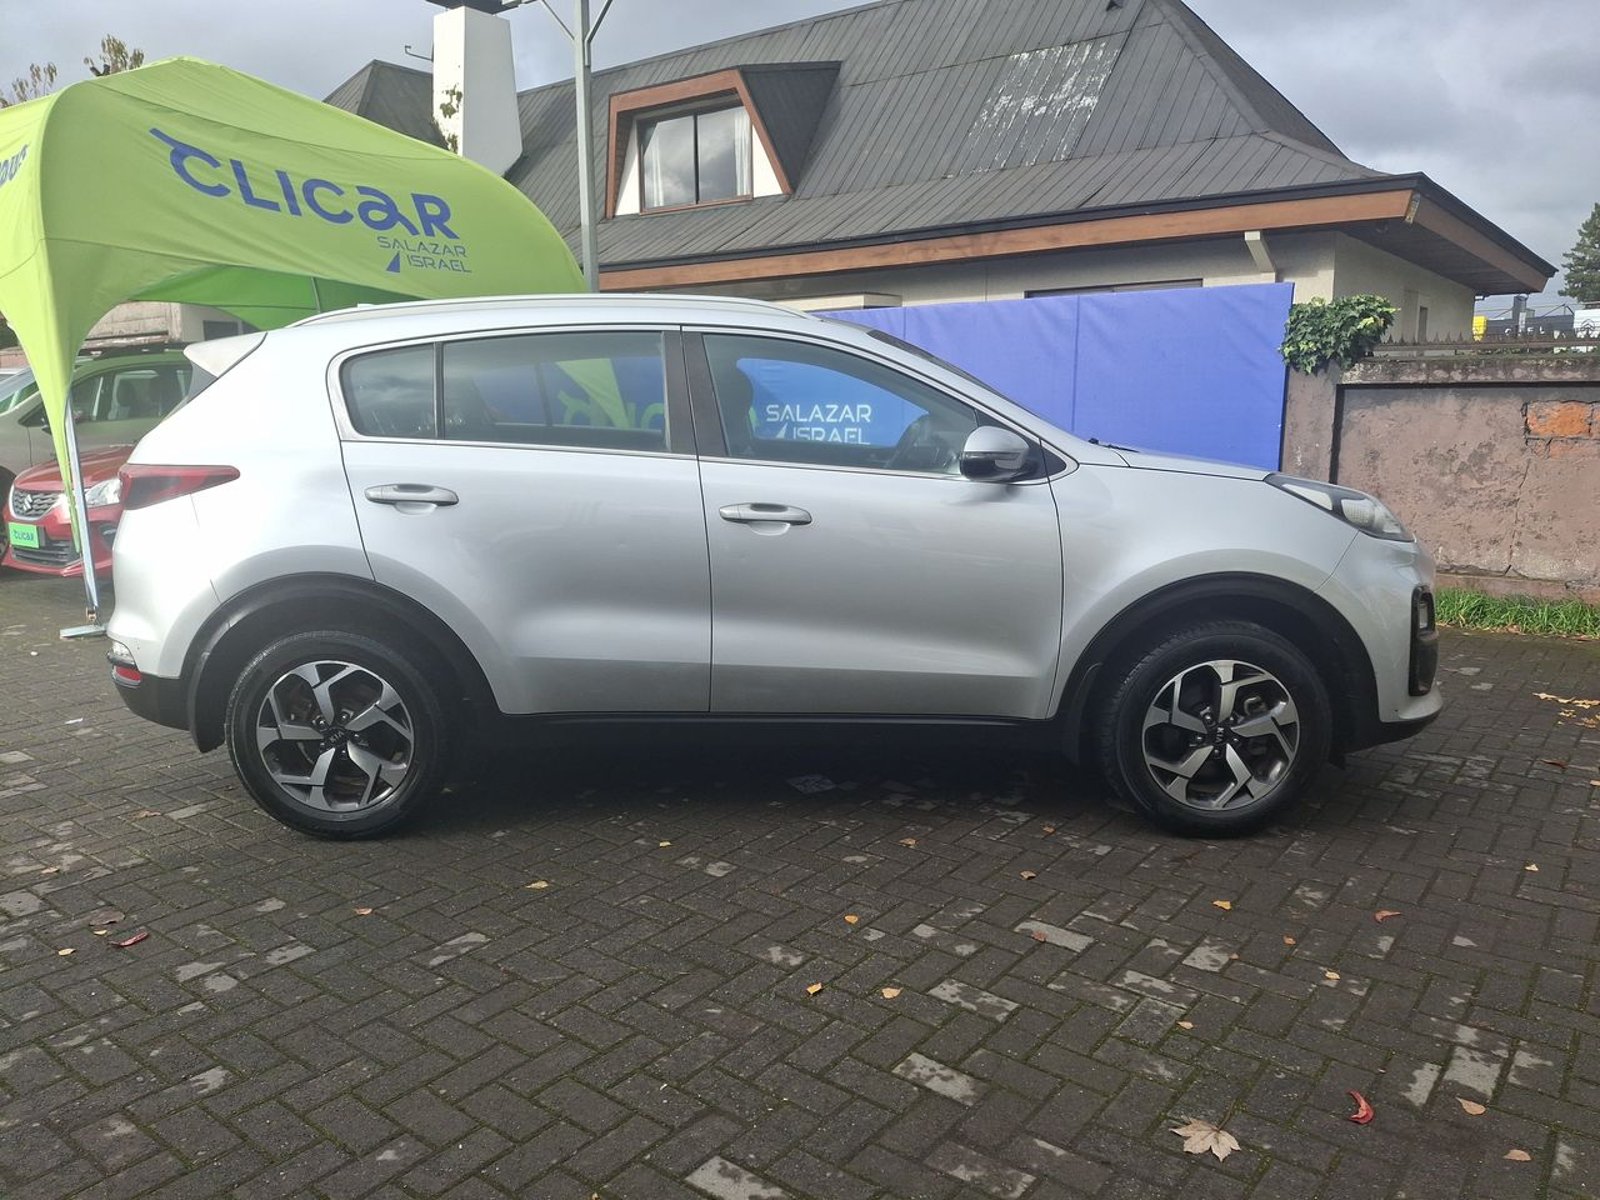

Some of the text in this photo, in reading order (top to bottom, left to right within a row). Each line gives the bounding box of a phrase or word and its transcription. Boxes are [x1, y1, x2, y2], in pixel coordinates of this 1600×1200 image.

[377, 235, 468, 258] SALAZAR
[407, 254, 472, 274] ISRAEL
[765, 404, 872, 423] SALAZAR
[793, 426, 871, 445] ISRAEL
